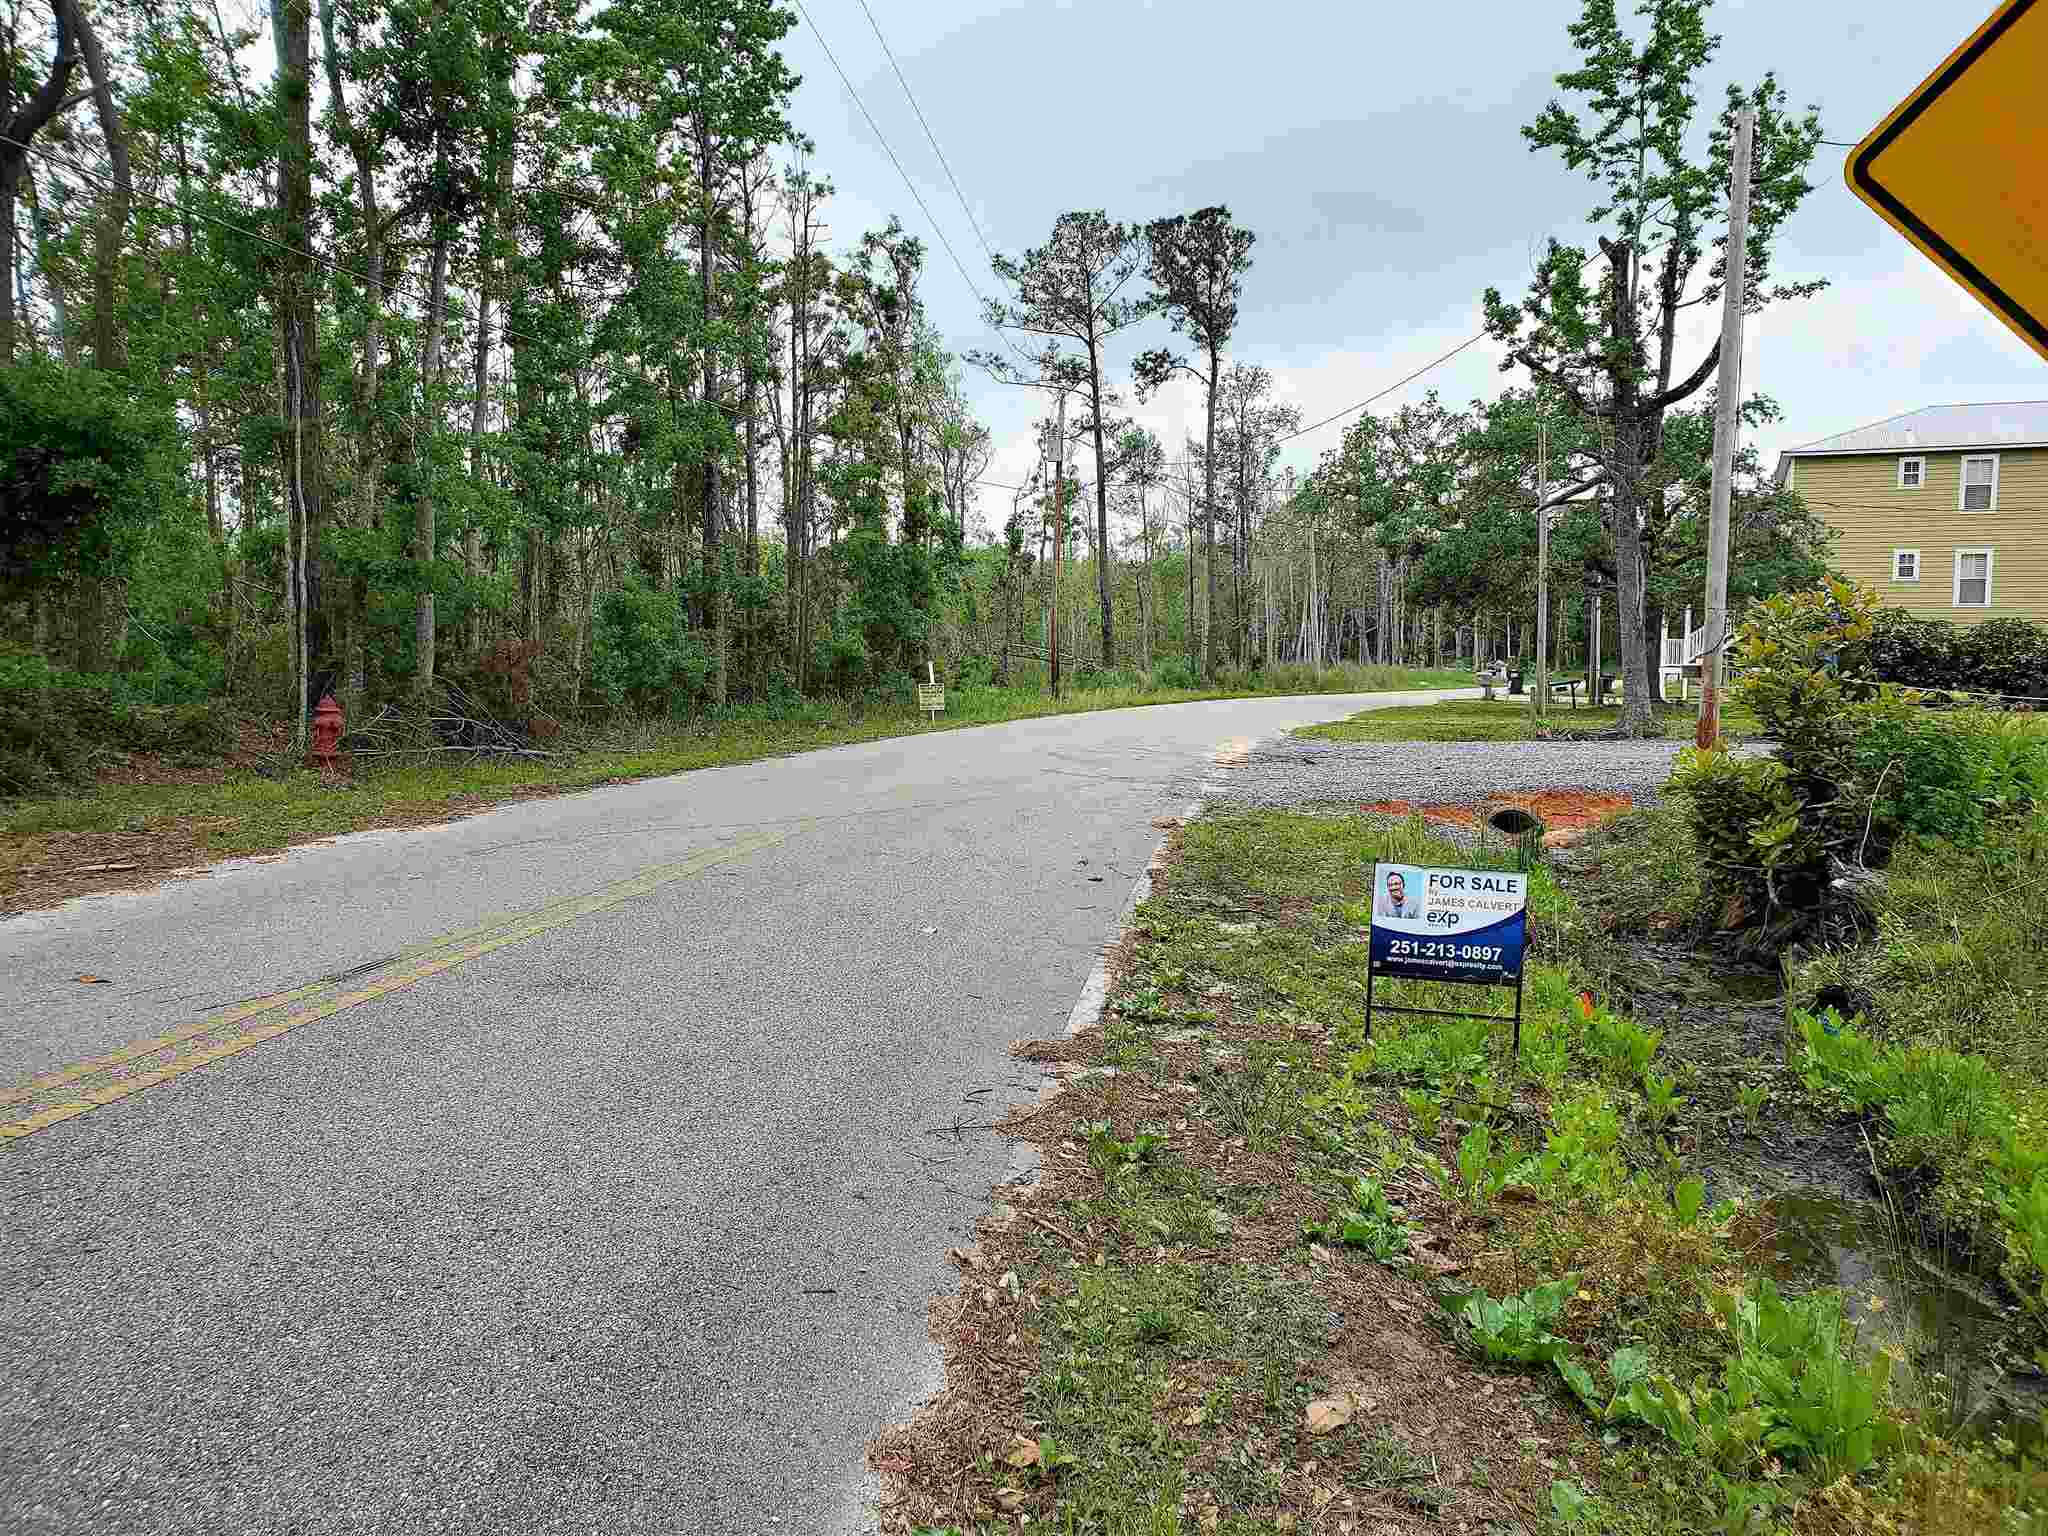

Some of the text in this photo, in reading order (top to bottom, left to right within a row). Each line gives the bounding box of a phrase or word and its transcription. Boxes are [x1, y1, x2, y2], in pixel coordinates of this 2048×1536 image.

[1429, 874, 1518, 893] FOR SALE
[1428, 897, 1520, 911] JAMES CALVERT
[1389, 940, 1503, 962] 251-213-0897
